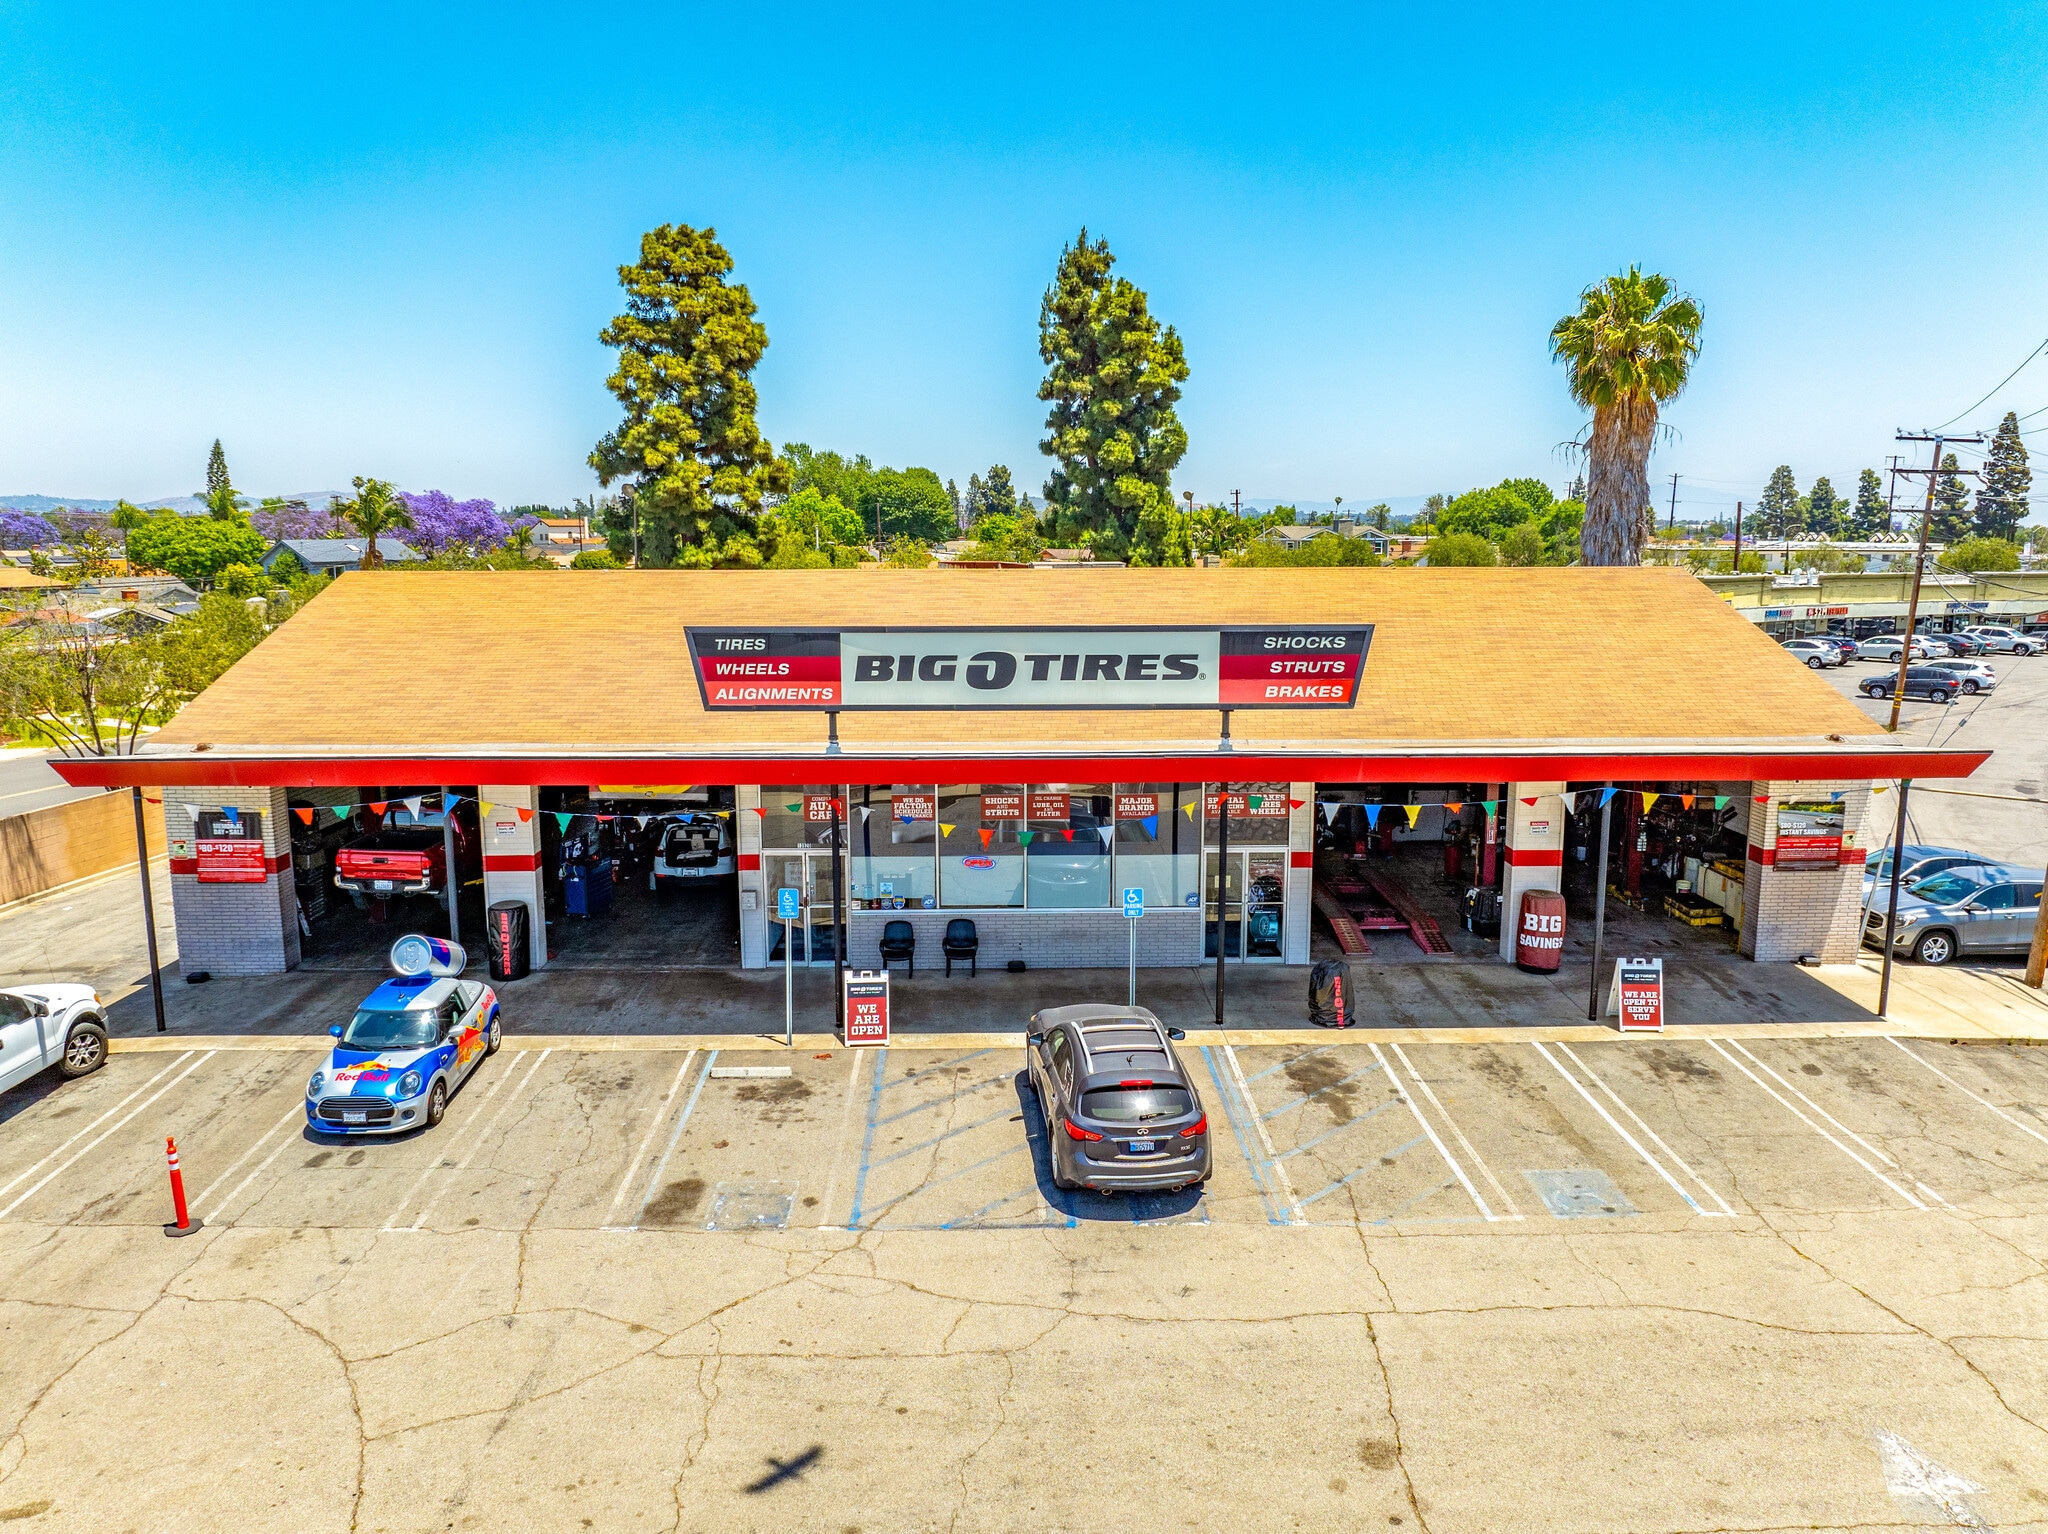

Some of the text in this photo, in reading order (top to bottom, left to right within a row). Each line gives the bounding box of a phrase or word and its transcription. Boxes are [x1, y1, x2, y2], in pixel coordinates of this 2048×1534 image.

[714, 638, 766, 651] TIRES
[1263, 636, 1346, 649] SHOCKS
[715, 663, 790, 675] WHEELS
[854, 654, 958, 682] BIG
[965, 651, 1018, 690] O
[1269, 661, 1345, 674] STRUTS
[715, 688, 833, 700] ALIGNMENTS
[1264, 685, 1344, 698] BRAKES
[809, 801, 842, 811] AUT
[985, 808, 1020, 816] STRUTS
[809, 811, 842, 820] CAR
[1523, 912, 1562, 933] BIG
[1519, 933, 1564, 949] SAVINGS
[857, 1004, 877, 1013] WE
[854, 1015, 879, 1024] ARE
[1632, 1013, 1651, 1021] YOU
[851, 1026, 883, 1035] OPEN
[335, 1071, 390, 1082] Red Bull
